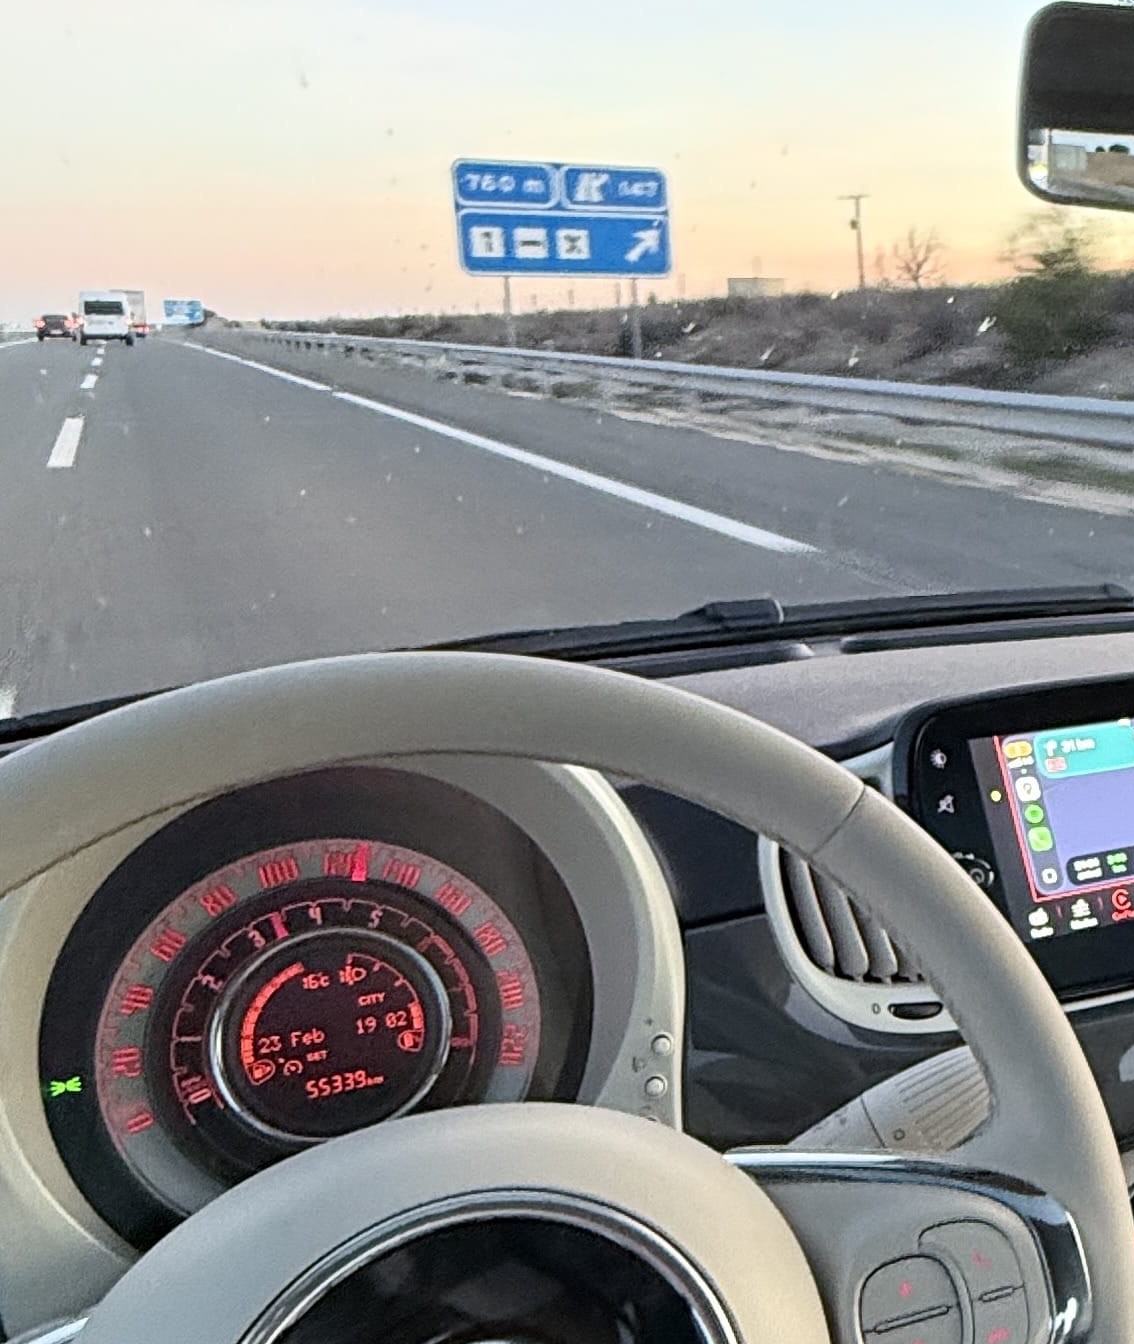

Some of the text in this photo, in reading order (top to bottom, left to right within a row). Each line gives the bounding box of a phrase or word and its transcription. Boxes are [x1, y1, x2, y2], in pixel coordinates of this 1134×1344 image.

[200, 885, 236, 917] 80
[308, 906, 322, 925] 4
[368, 909, 383, 929] 5
[248, 929, 266, 948] 3
[201, 974, 223, 992] 2
[358, 992, 385, 1006] CITY
[356, 1016, 377, 1035] 19
[258, 1028, 326, 1054] 23 Feb
[126, 1112, 154, 1133] 0
